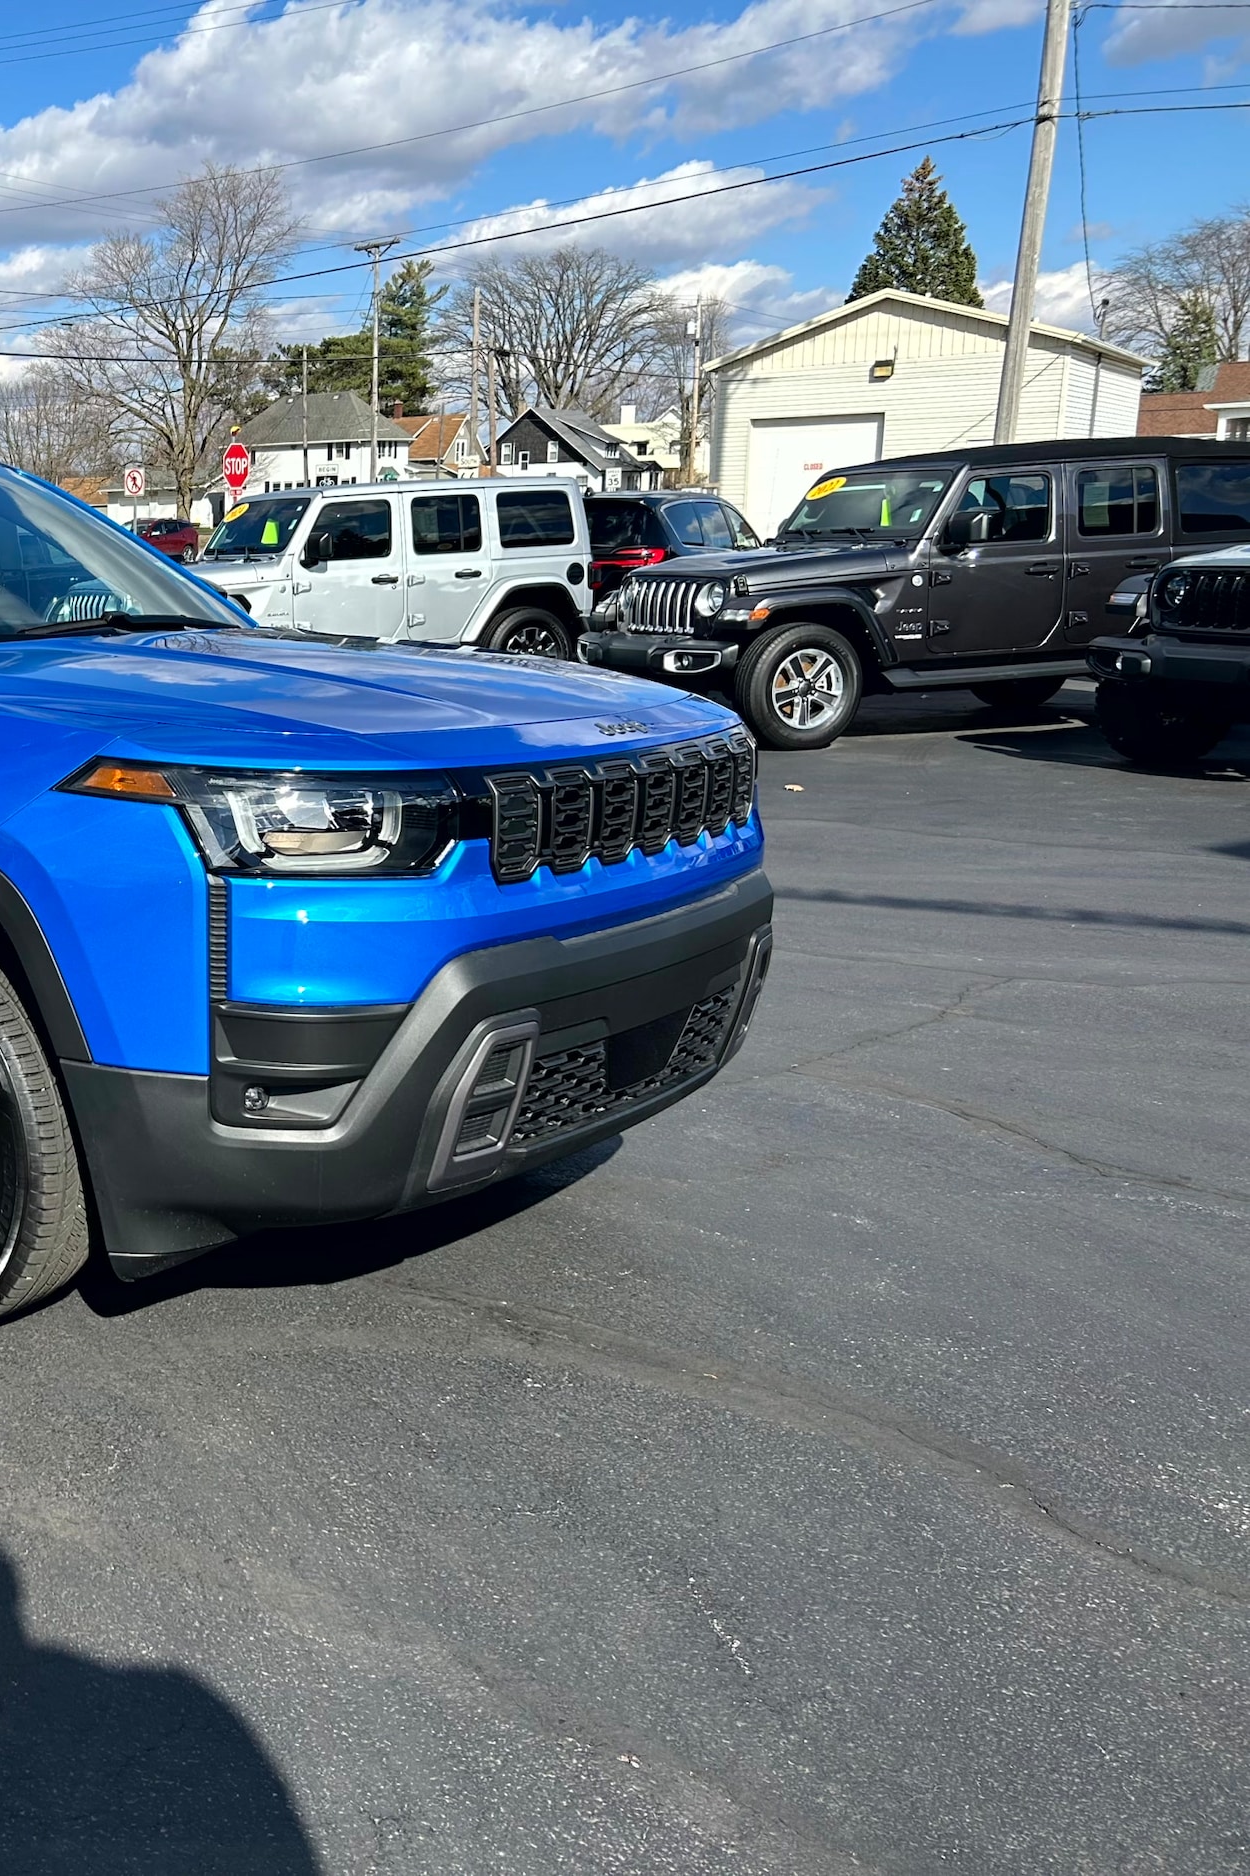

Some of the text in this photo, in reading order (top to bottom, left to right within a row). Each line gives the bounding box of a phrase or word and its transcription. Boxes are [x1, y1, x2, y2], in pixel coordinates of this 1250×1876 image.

[225, 457, 247, 475] STOP
[607, 478, 619, 486] 35
[895, 621, 922, 632] Jeep
[594, 722, 649, 736] Jeep
